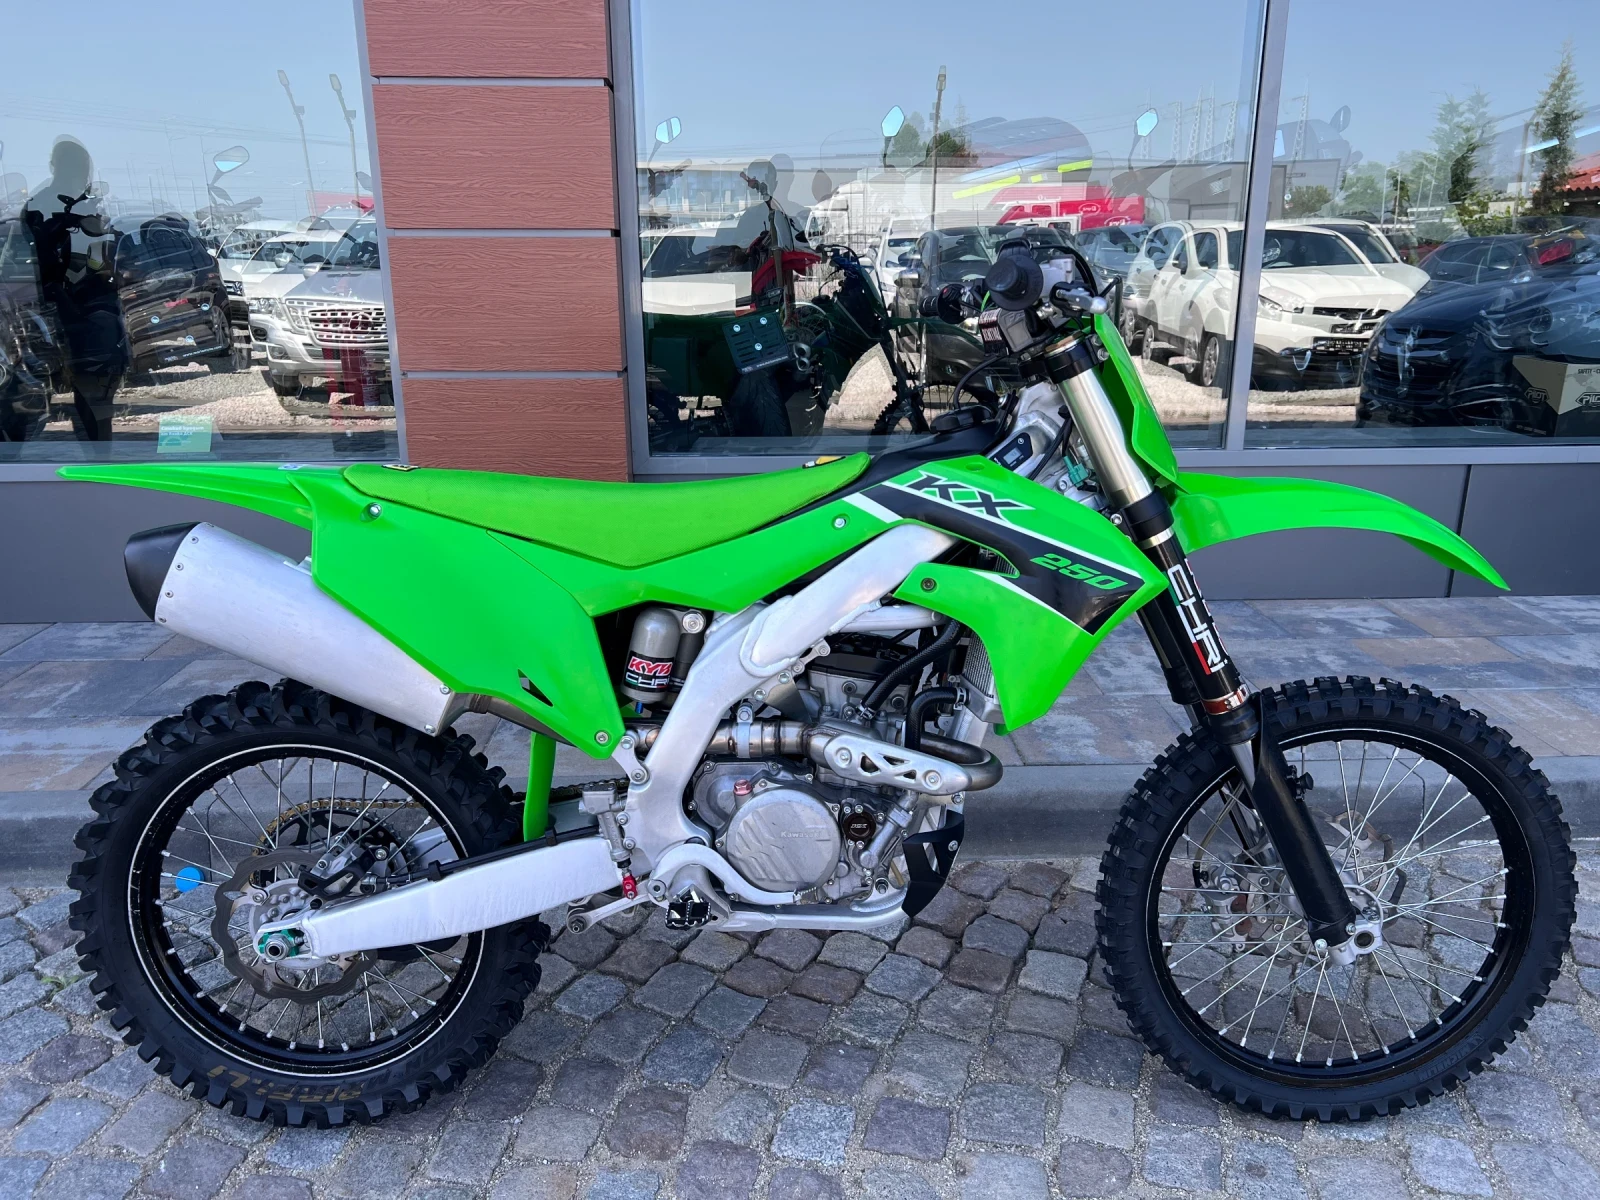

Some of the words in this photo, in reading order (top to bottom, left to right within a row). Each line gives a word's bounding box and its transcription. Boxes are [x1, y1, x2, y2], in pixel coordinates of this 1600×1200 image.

[905, 470, 1035, 522] KX
[1030, 553, 1128, 590] 250
[628, 656, 673, 676] KYB
